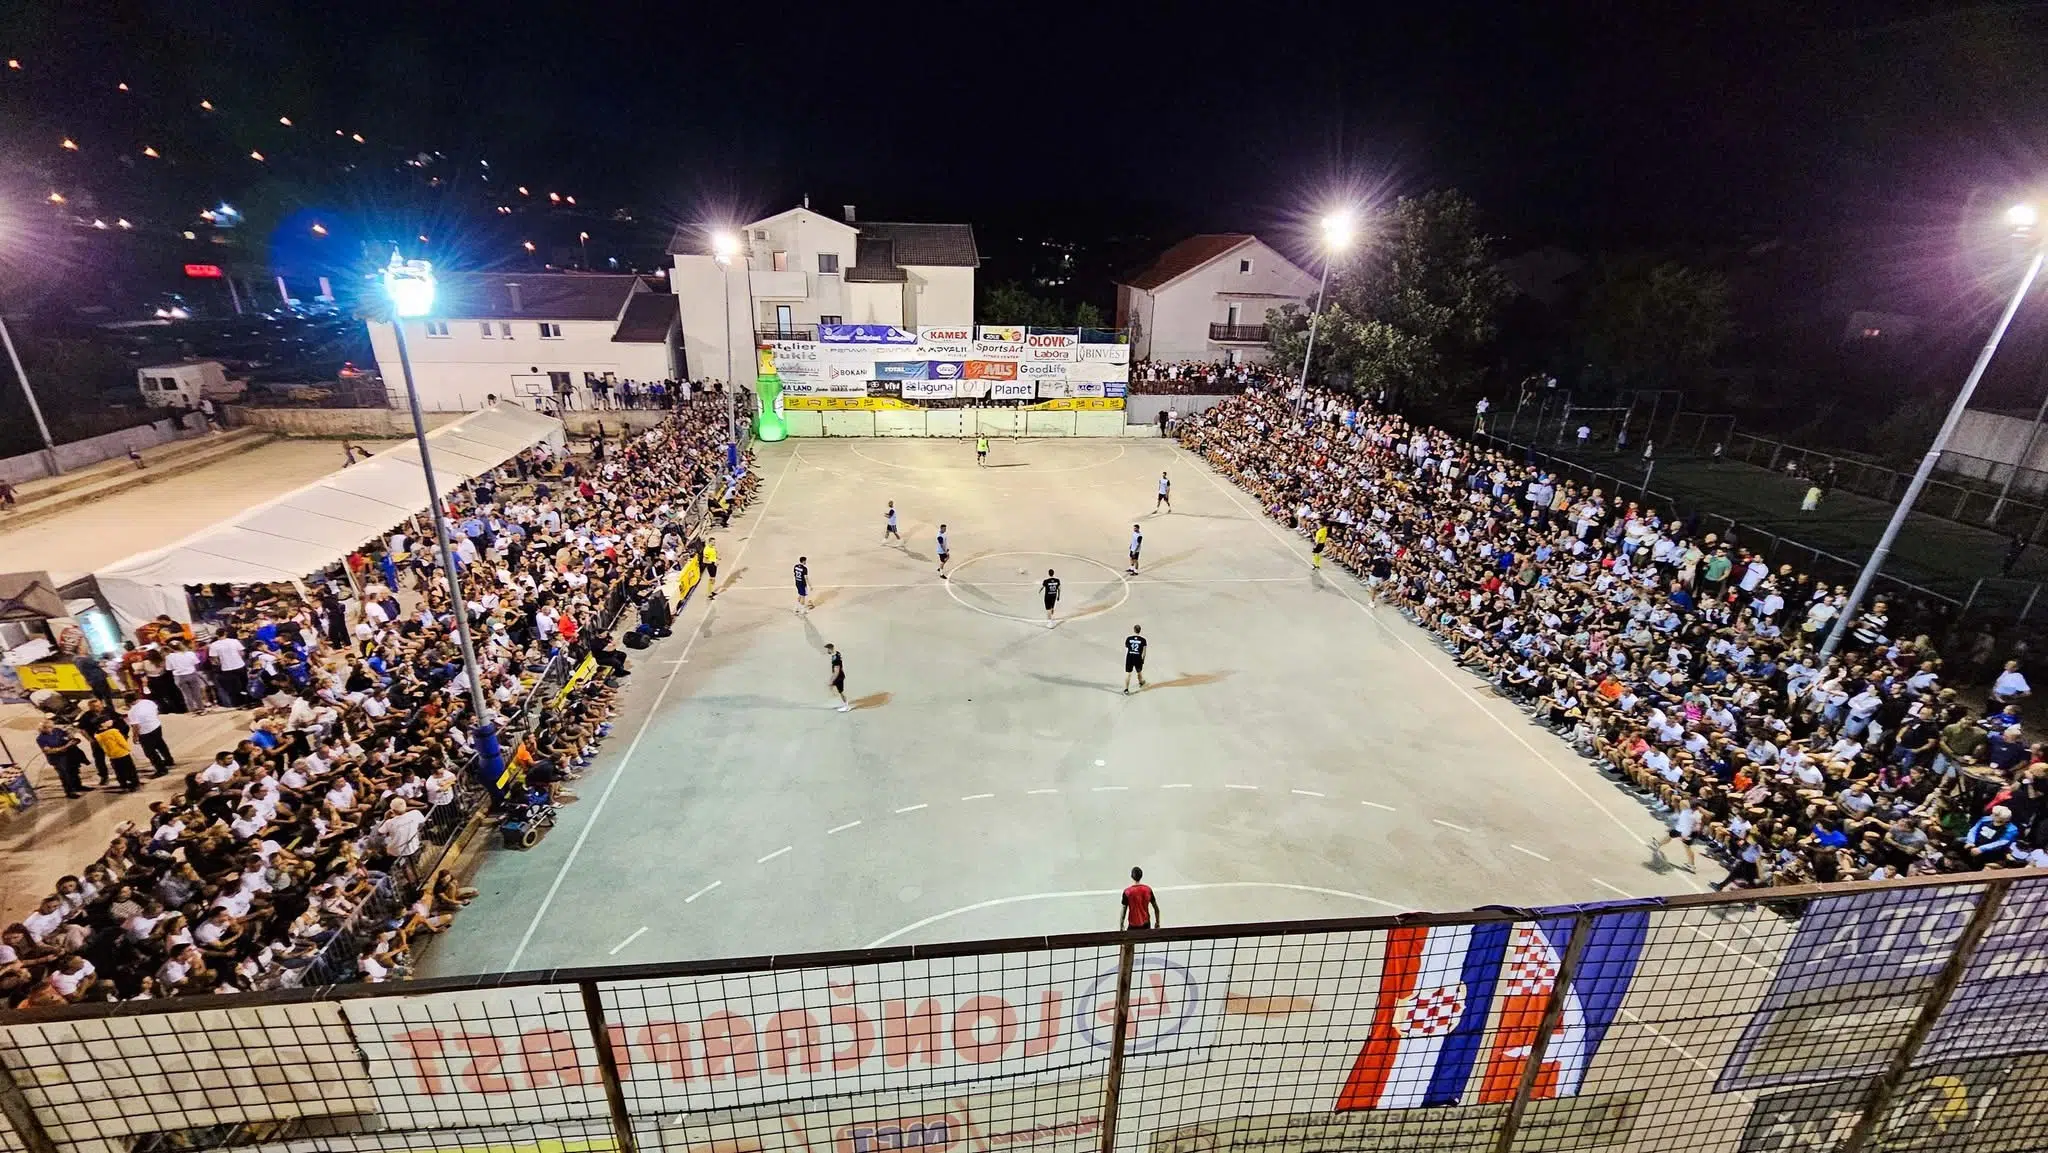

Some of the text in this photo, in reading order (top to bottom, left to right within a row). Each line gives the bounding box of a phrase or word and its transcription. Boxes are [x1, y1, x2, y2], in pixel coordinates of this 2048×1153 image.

[930, 331, 968, 340] KAMEX
[976, 343, 1024, 352] SportsArt
[1020, 364, 1067, 374] GoodLife
[917, 381, 953, 394] laguna
[995, 384, 1032, 395] Planet
